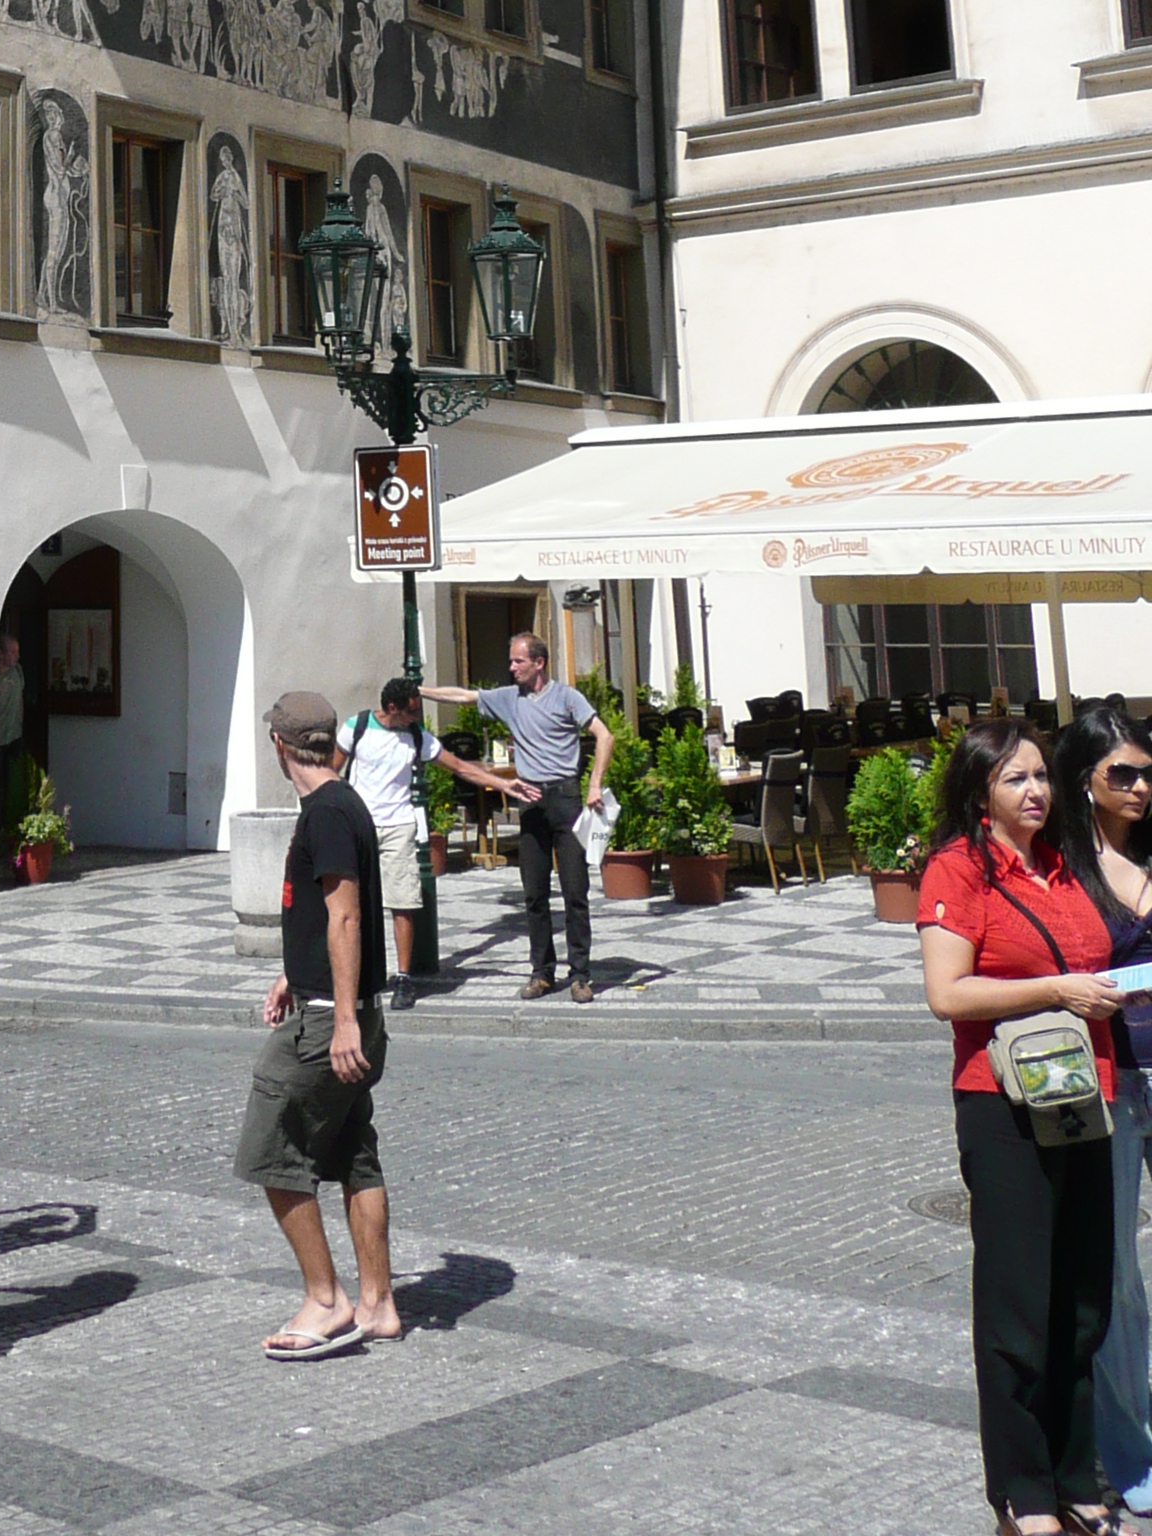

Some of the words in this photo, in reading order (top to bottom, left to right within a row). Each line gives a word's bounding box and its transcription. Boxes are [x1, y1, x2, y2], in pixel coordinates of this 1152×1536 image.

[648, 482, 890, 520] Pilsner
[892, 473, 1132, 500] Urquell
[367, 546, 401, 562] Meeting
[403, 545, 425, 562] point
[538, 550, 621, 566] RESTAURACE
[623, 549, 634, 565] U
[636, 548, 688, 564] MINUTY
[792, 538, 832, 568] Pilsner
[830, 536, 868, 559] Urquell
[948, 538, 1056, 557] RESTAURACE
[1060, 539, 1073, 555] U
[1078, 536, 1147, 555] MINUTY
